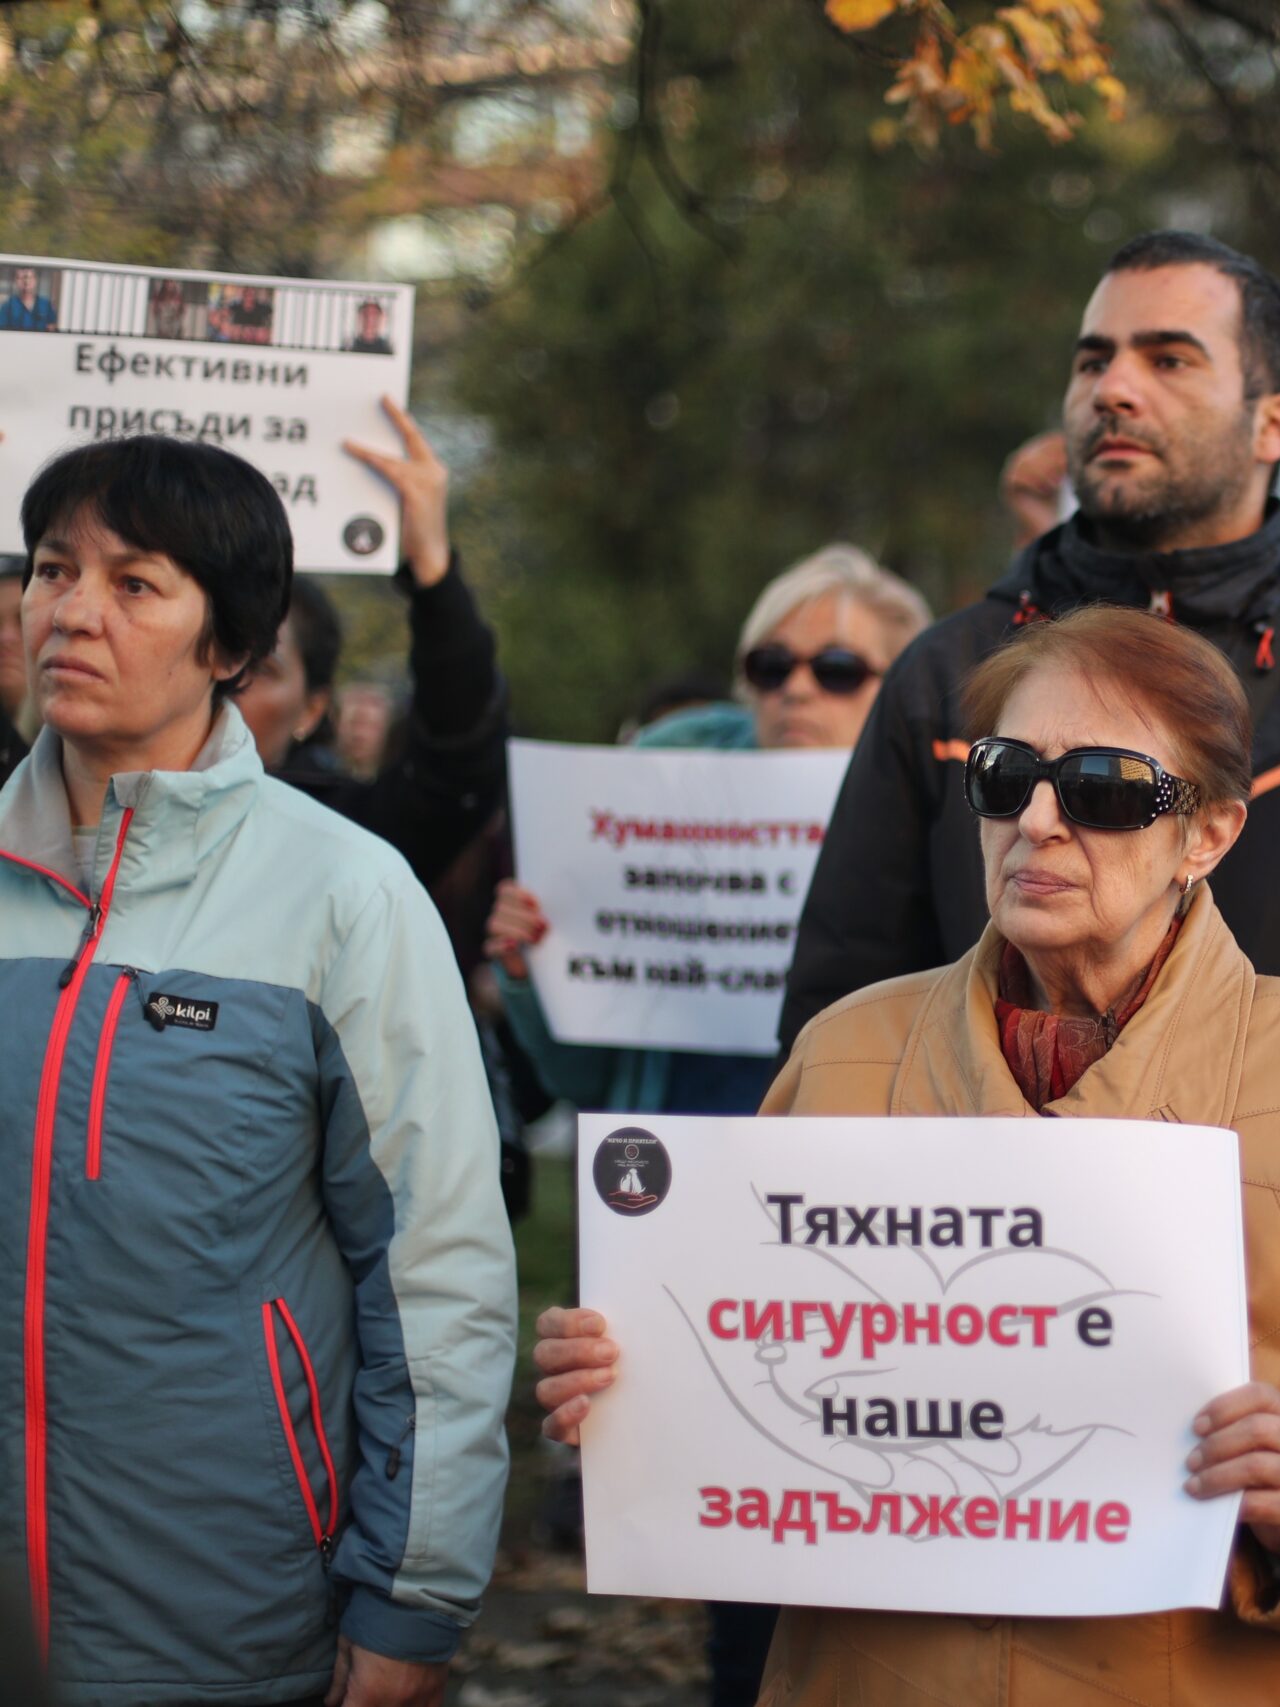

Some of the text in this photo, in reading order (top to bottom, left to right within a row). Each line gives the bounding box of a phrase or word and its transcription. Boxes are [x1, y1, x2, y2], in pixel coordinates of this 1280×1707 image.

[74, 342, 310, 386] Ефективни
[68, 403, 309, 442] присъди за
[273, 471, 318, 505] ад
[644, 958, 789, 995] най-сла
[175, 1003, 211, 1021] kilpi
[766, 1194, 1043, 1249] Тяхната
[706, 1298, 1113, 1360] сигурност е
[820, 1397, 1005, 1441] наше
[698, 1485, 1131, 1546] задължение
